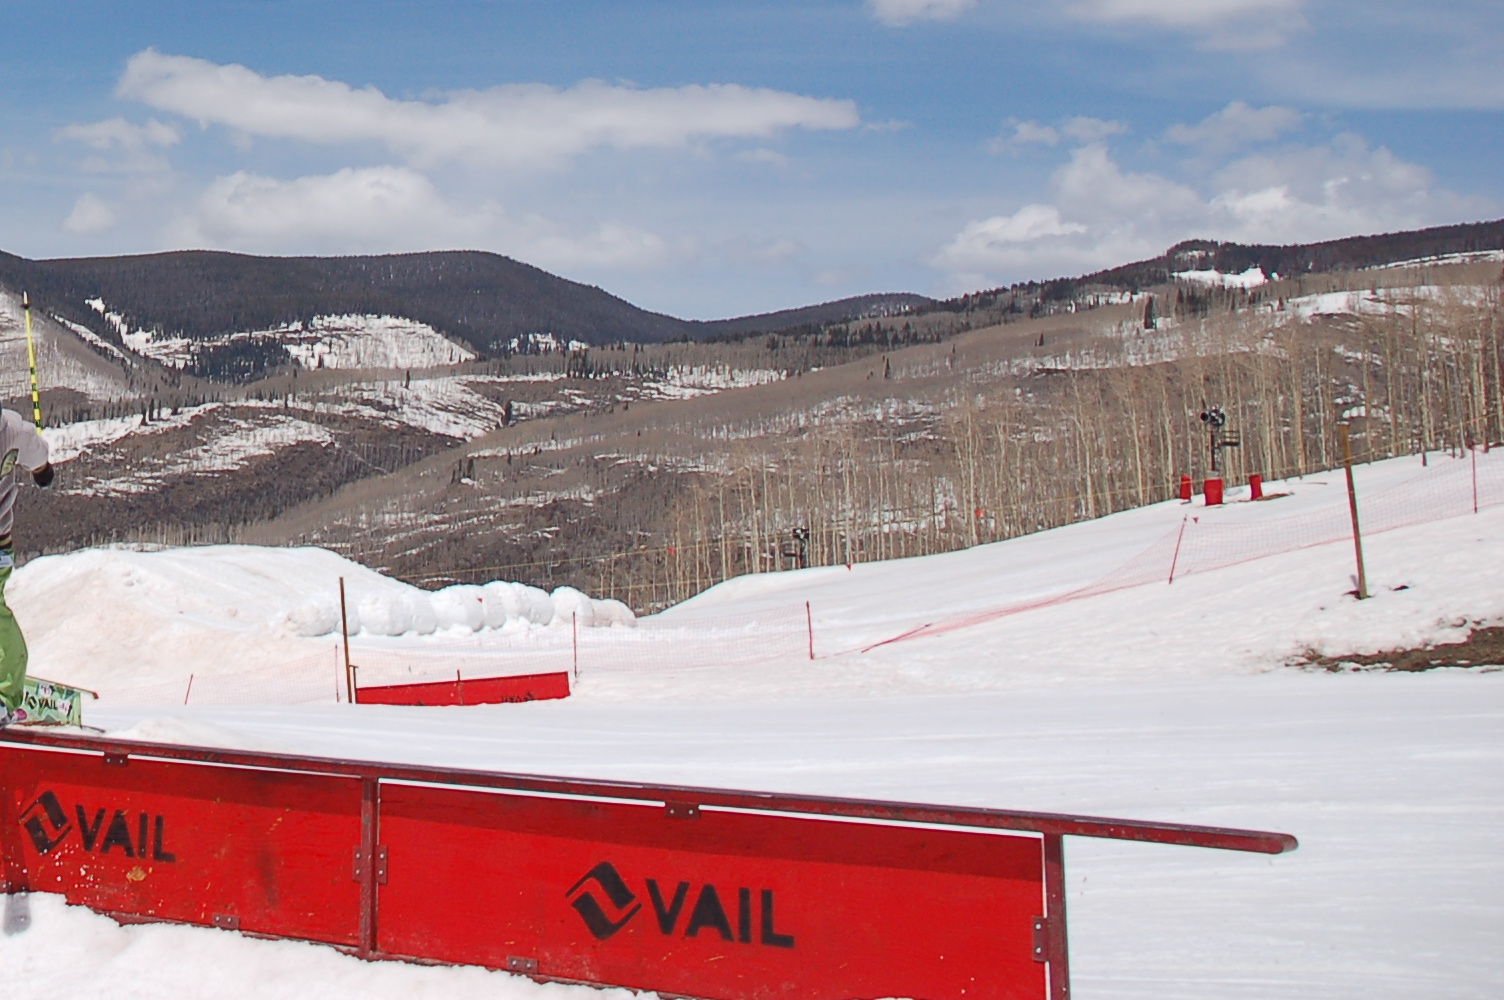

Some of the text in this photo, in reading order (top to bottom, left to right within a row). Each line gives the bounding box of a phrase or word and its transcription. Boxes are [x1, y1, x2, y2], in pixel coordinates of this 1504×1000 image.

[38, 698, 59, 711] VAIL
[75, 804, 177, 863] VAIL
[645, 878, 795, 949] VAIL
